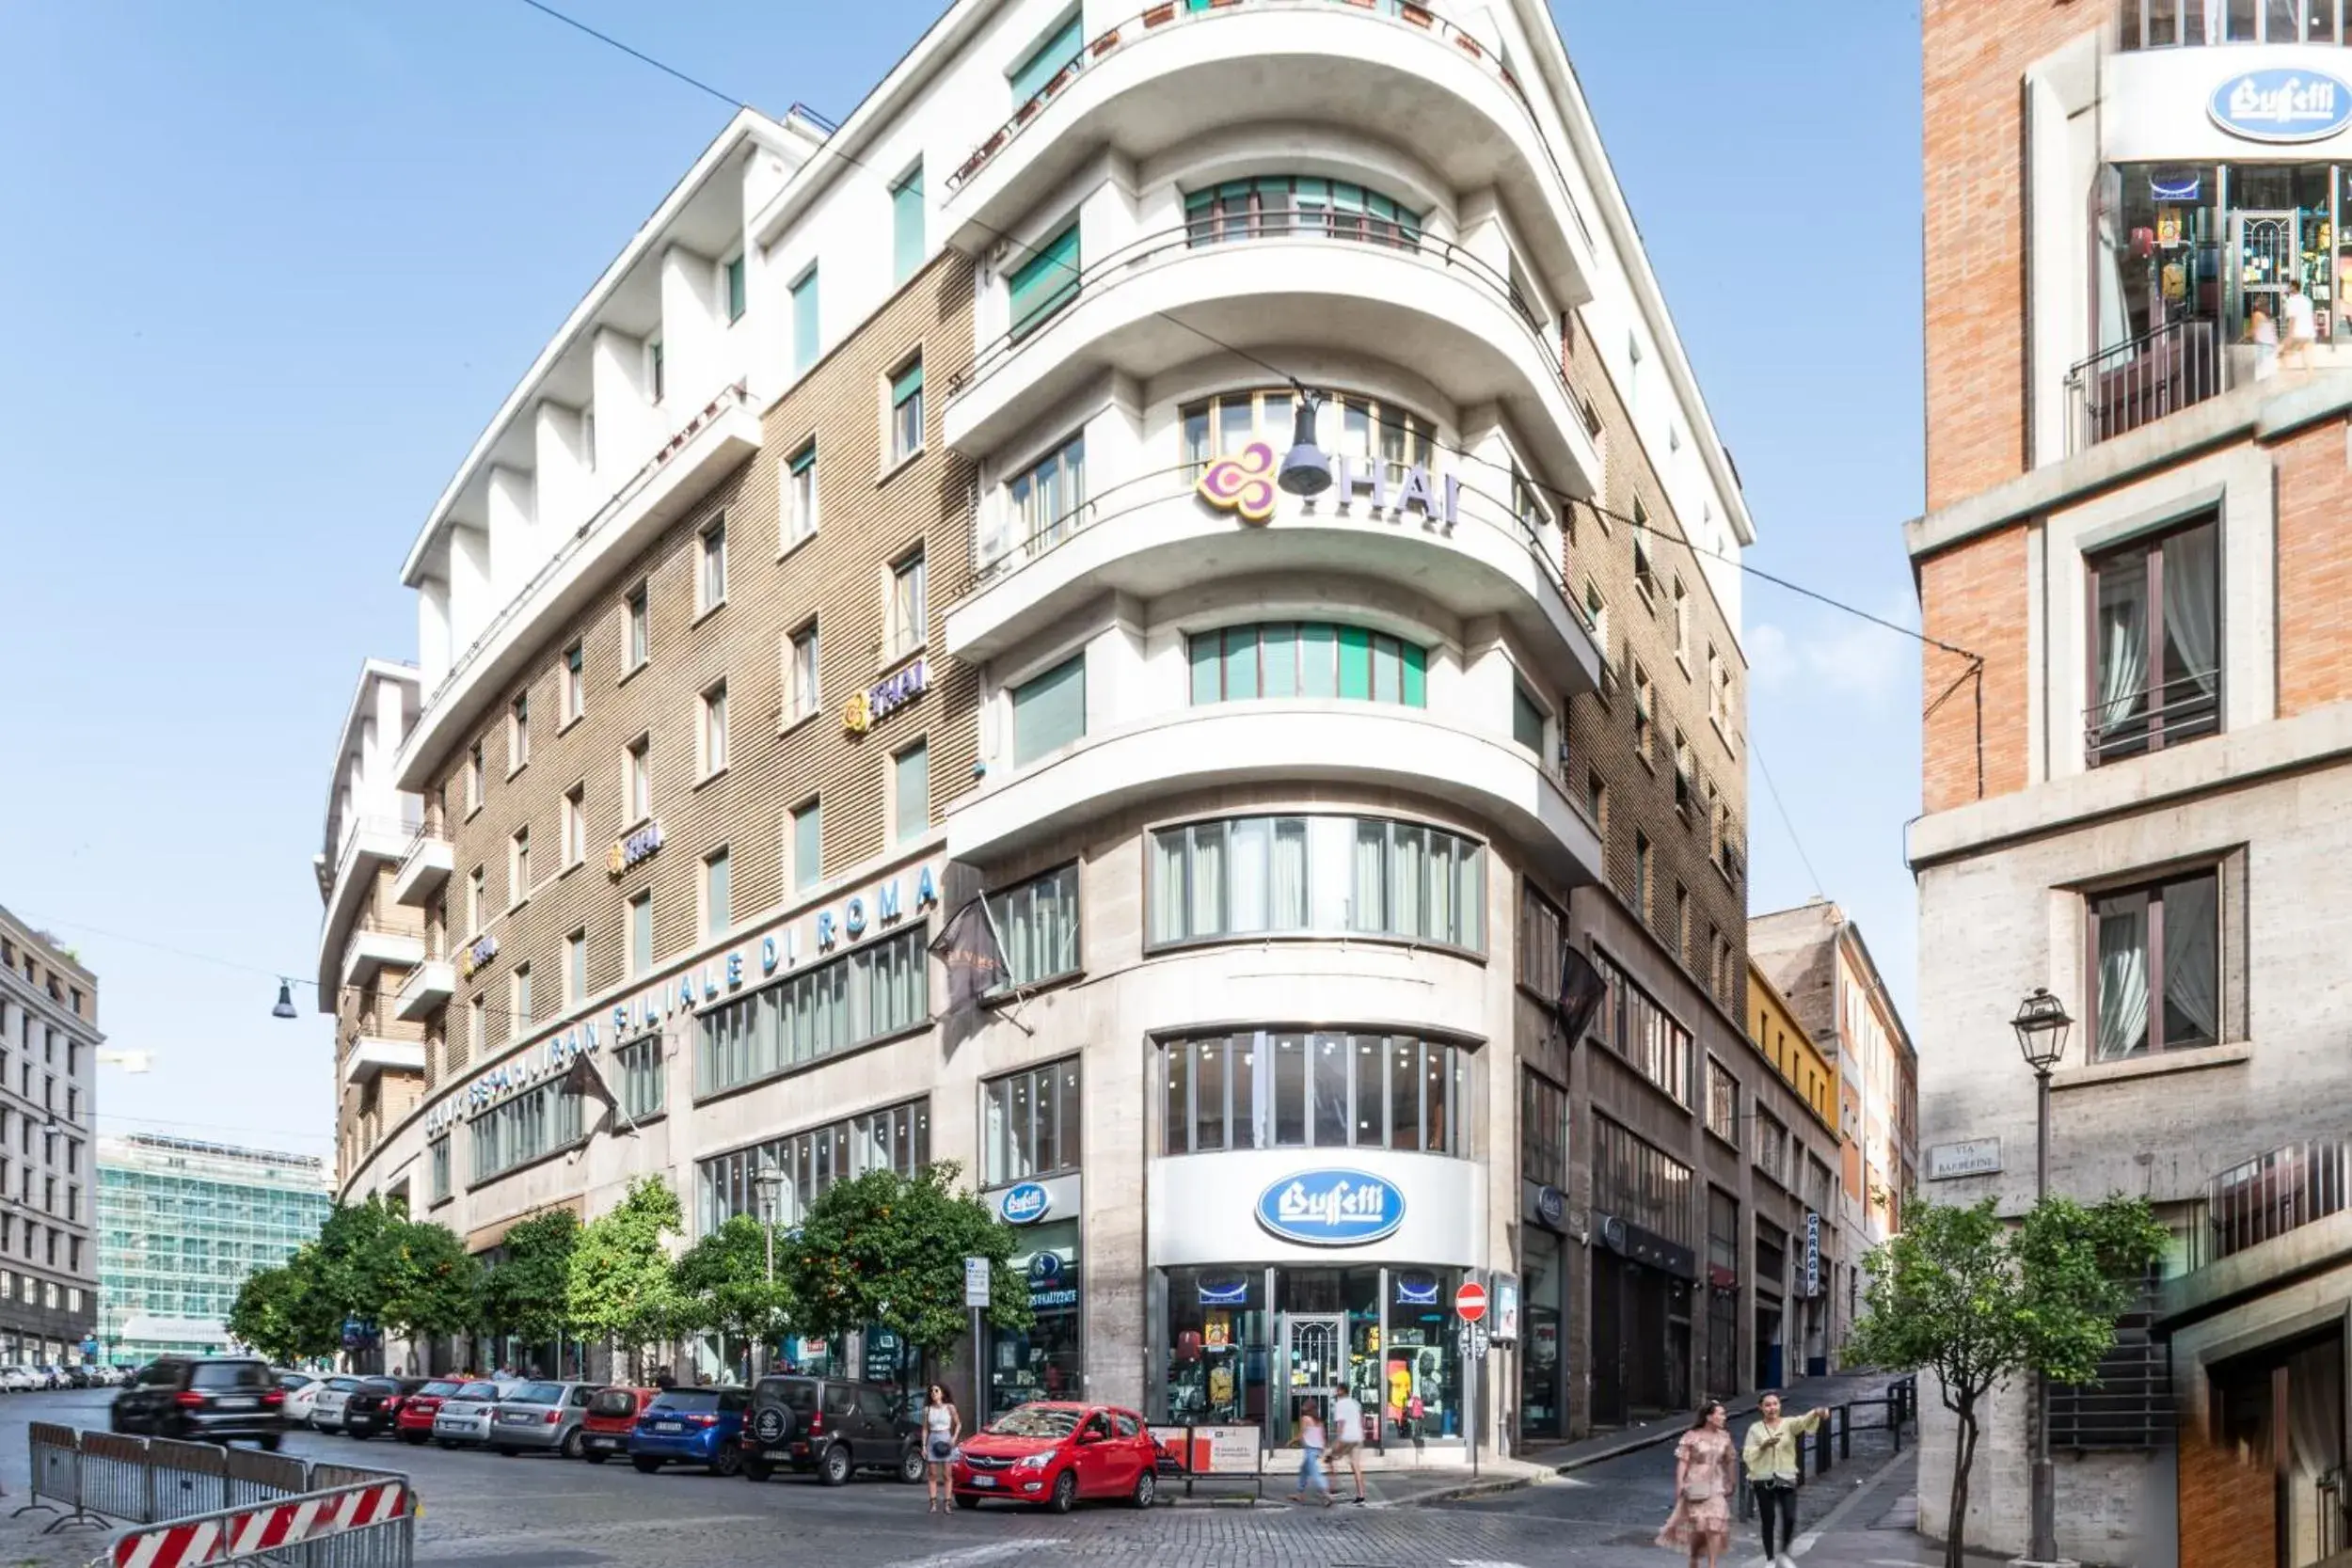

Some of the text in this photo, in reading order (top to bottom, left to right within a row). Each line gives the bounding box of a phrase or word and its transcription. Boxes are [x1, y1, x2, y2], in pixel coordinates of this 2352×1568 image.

[2230, 77, 2335, 123] Buffetti
[1301, 453, 1459, 525] HAI
[543, 1019, 599, 1072] IRAN
[613, 951, 745, 1036] FILIALE
[763, 928, 799, 971] DI
[817, 865, 939, 947] ROMA
[1279, 1180, 1383, 1226] Buffetti
[1808, 1215, 1818, 1280] GARAGE
